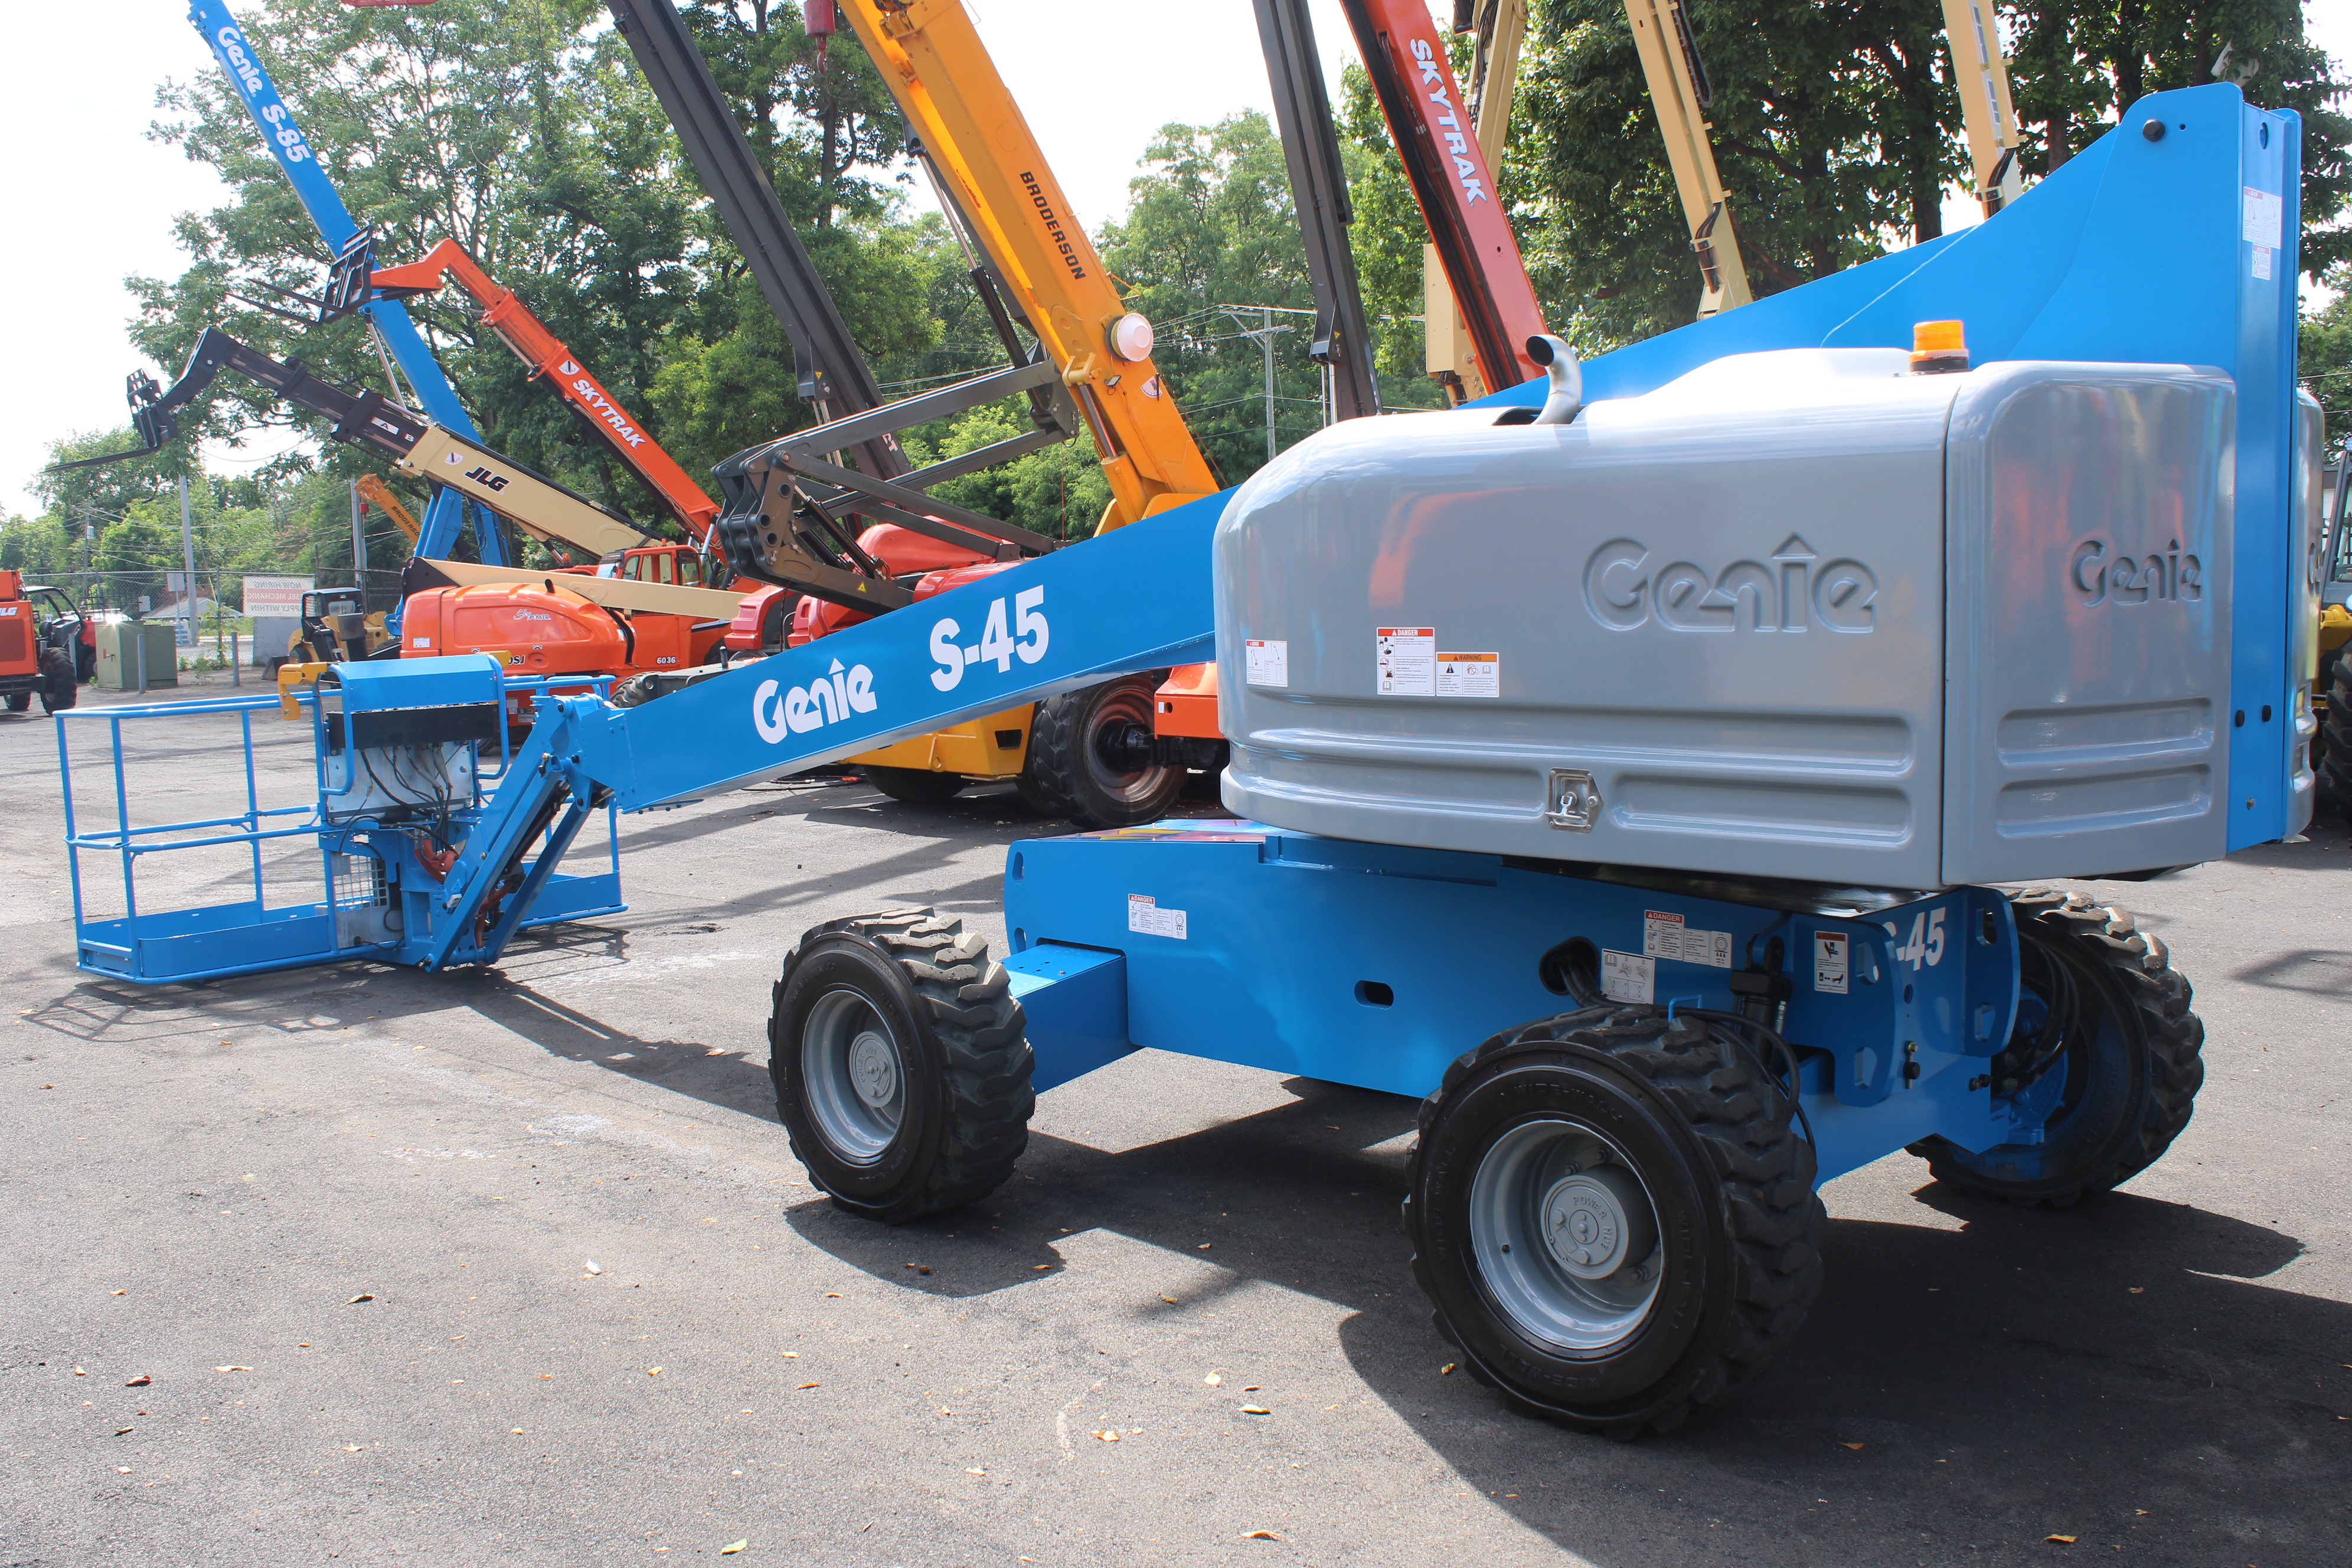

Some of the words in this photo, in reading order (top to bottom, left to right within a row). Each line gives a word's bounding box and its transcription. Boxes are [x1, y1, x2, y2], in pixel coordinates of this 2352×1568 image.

[218, 27, 263, 95] Genie
[262, 104, 312, 163] S-85
[1410, 38, 1487, 204] SKYTRAK
[1020, 171, 1086, 280] BRODERSON
[405, 433, 414, 442] B
[573, 379, 646, 449] SKYTRAK
[465, 466, 511, 492] JLG
[391, 506, 420, 538] BRODERSO
[1580, 532, 1880, 633] Genie
[2070, 538, 2202, 608] Genie
[656, 656, 677, 665] 6036
[930, 584, 1050, 692] S-45
[753, 658, 878, 744] Genie
[1653, 913, 1680, 922] DANGER
[1573, 1196, 1607, 1220] POWER
[1600, 1226, 1612, 1251] HUB
